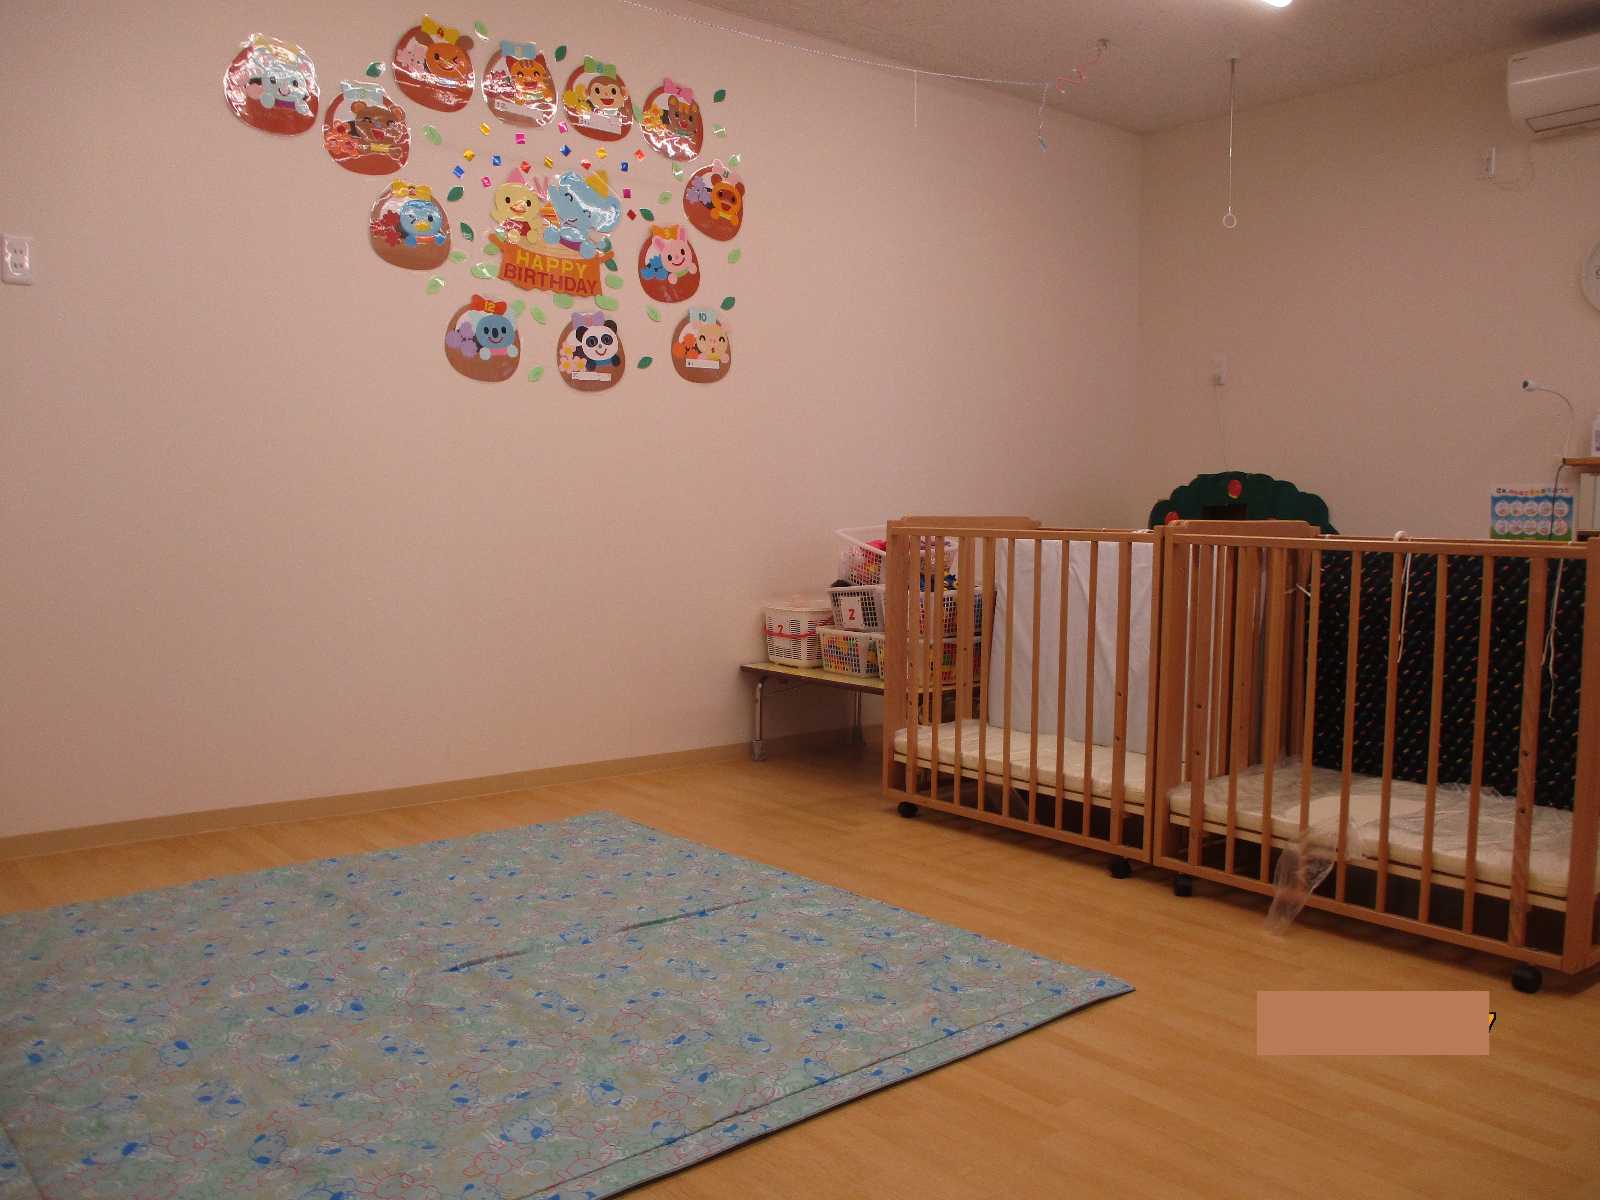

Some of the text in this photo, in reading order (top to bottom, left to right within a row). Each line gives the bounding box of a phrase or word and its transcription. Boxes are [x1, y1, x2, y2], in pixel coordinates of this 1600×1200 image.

[516, 249, 586, 279] HAPPY
[503, 262, 597, 295] BIRTHDAY
[484, 300, 495, 312] 12
[698, 311, 707, 322] 10
[848, 608, 856, 621] 2
